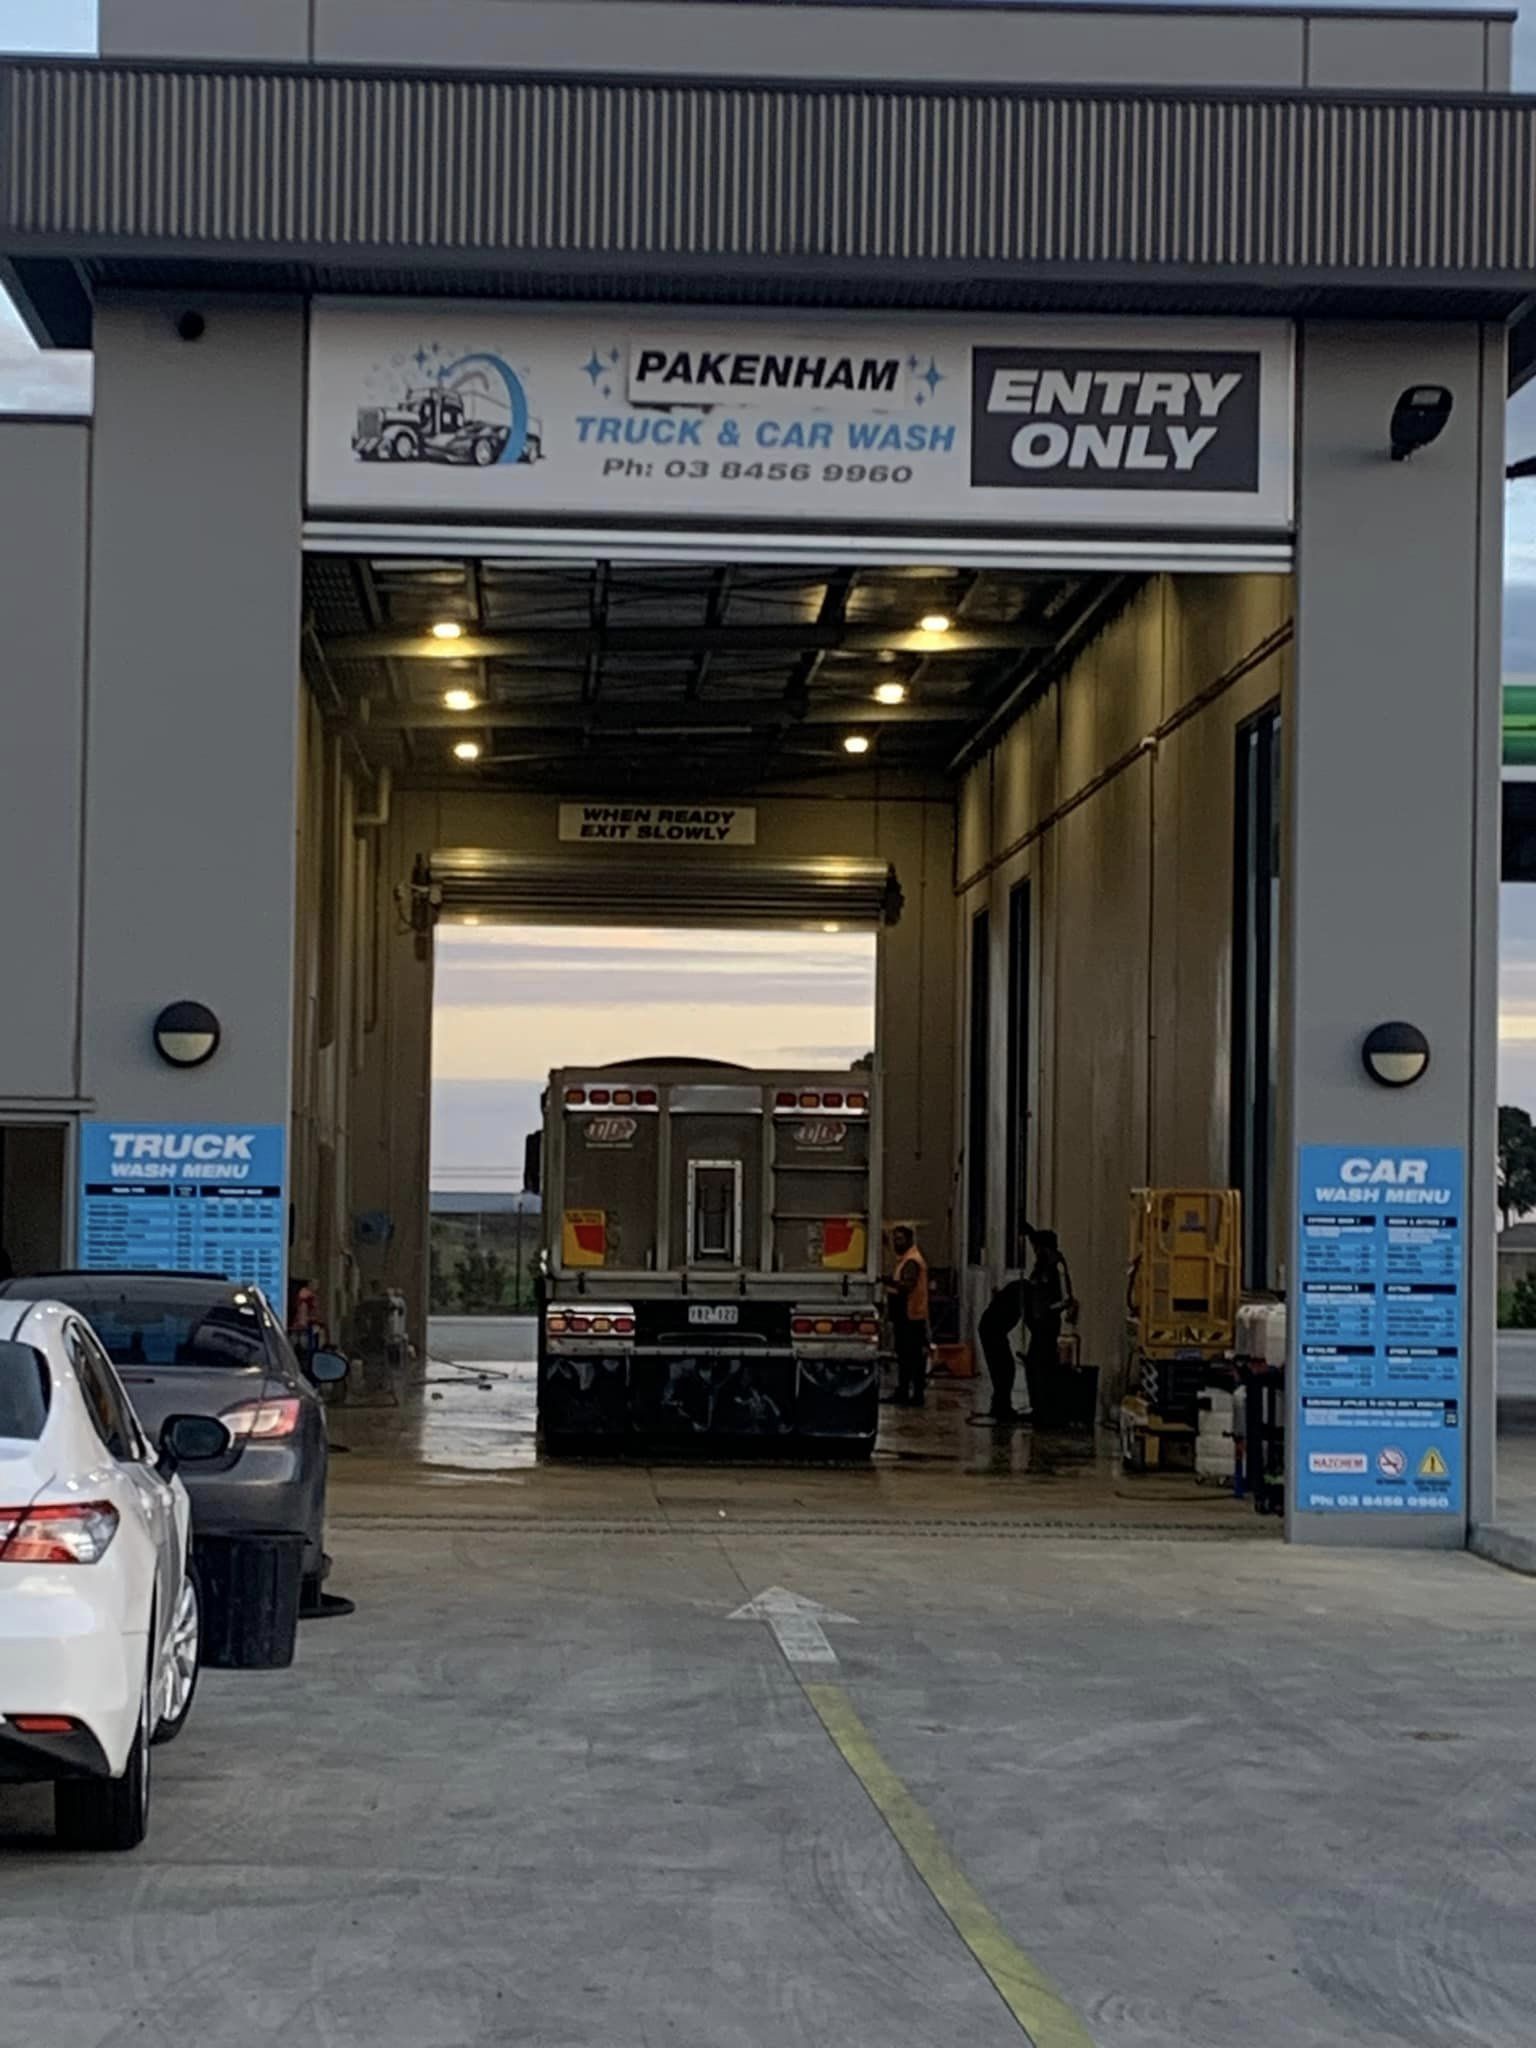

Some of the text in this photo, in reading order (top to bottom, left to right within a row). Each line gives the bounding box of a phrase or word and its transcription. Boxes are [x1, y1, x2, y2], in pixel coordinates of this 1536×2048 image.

[635, 350, 900, 391] PAKENHAM
[986, 368, 1243, 417] ENTRY
[575, 417, 956, 452] TRUCK & CAR WASH
[1010, 421, 1218, 471] ONLY
[601, 458, 913, 484] Ph: 03 8456 9960
[583, 807, 735, 825] WHEN READY
[580, 823, 731, 841] EXIT SLOWLY
[109, 1132, 256, 1160] TRUCK
[111, 1162, 250, 1180] WASH MENU
[1340, 1157, 1429, 1184] CAR
[1315, 1187, 1451, 1204] WASH MENU
